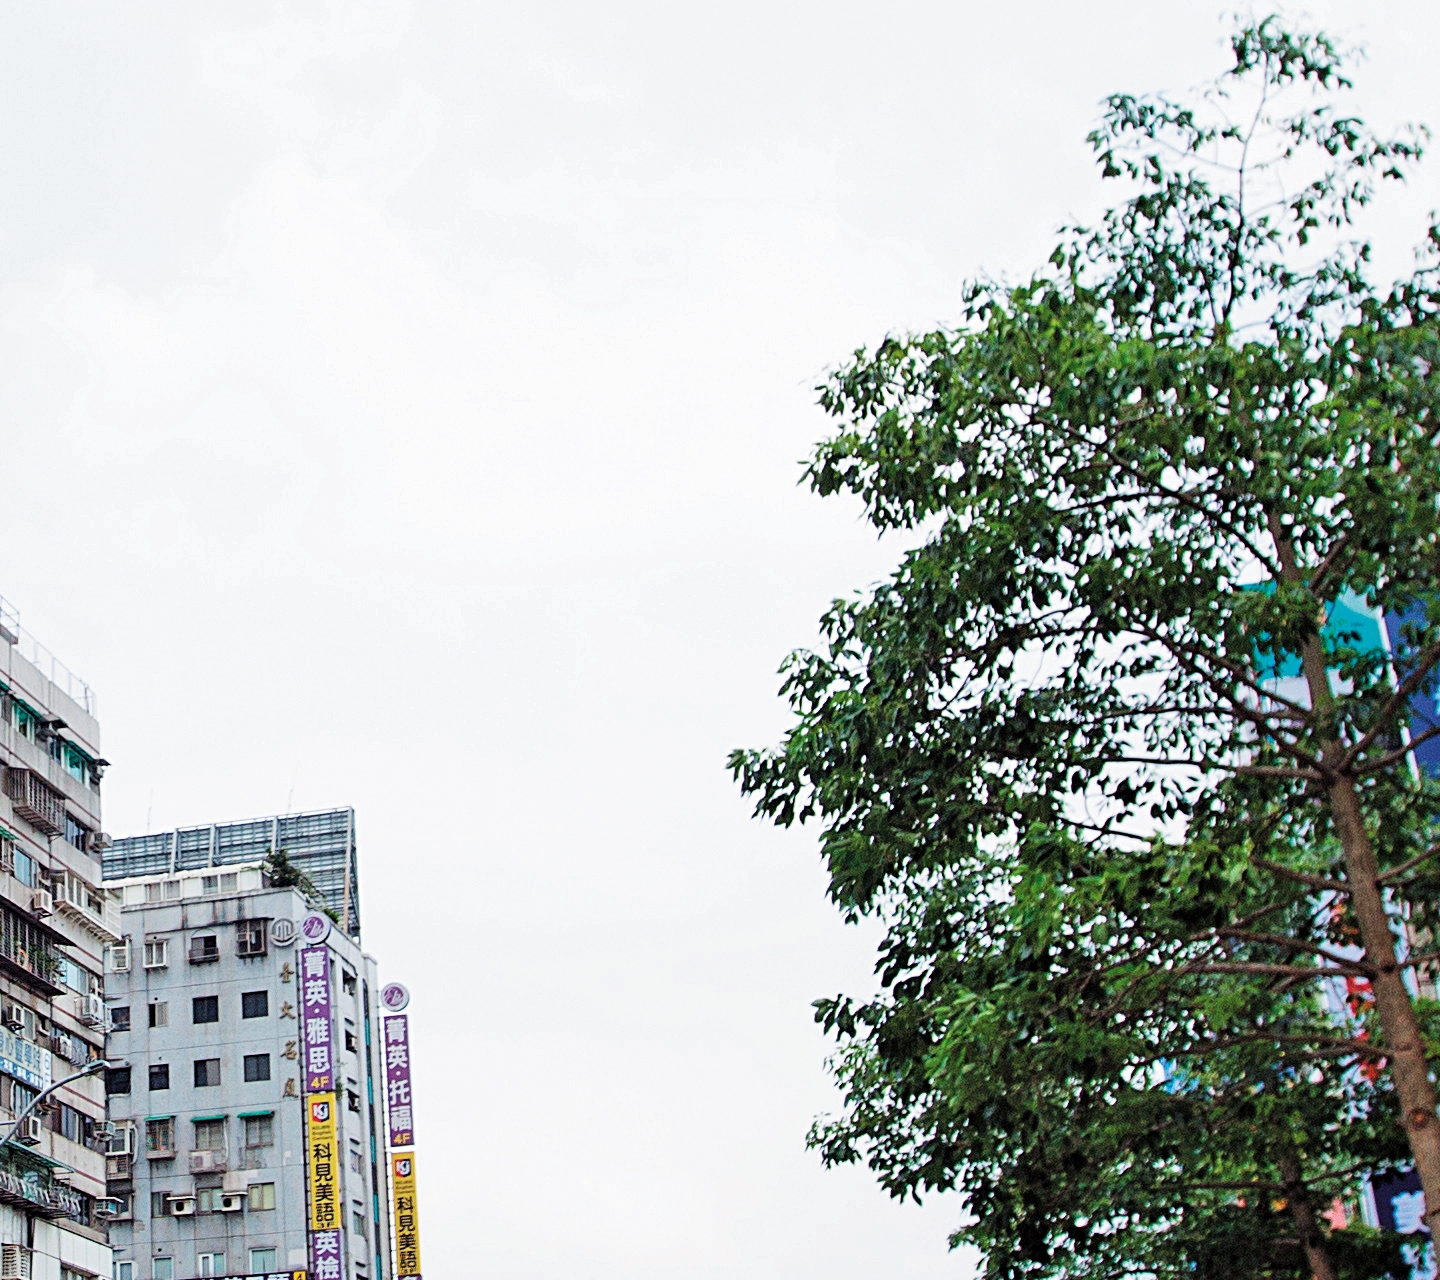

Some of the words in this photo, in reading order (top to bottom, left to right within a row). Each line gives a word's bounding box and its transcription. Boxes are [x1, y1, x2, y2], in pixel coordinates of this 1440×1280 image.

[311, 1075, 330, 1089] 4F
[394, 1132, 411, 1144] 4F
[313, 1142, 335, 1222] 科見美語
[315, 1231, 339, 1280] 英檢
[397, 1197, 417, 1268] 科見美語
